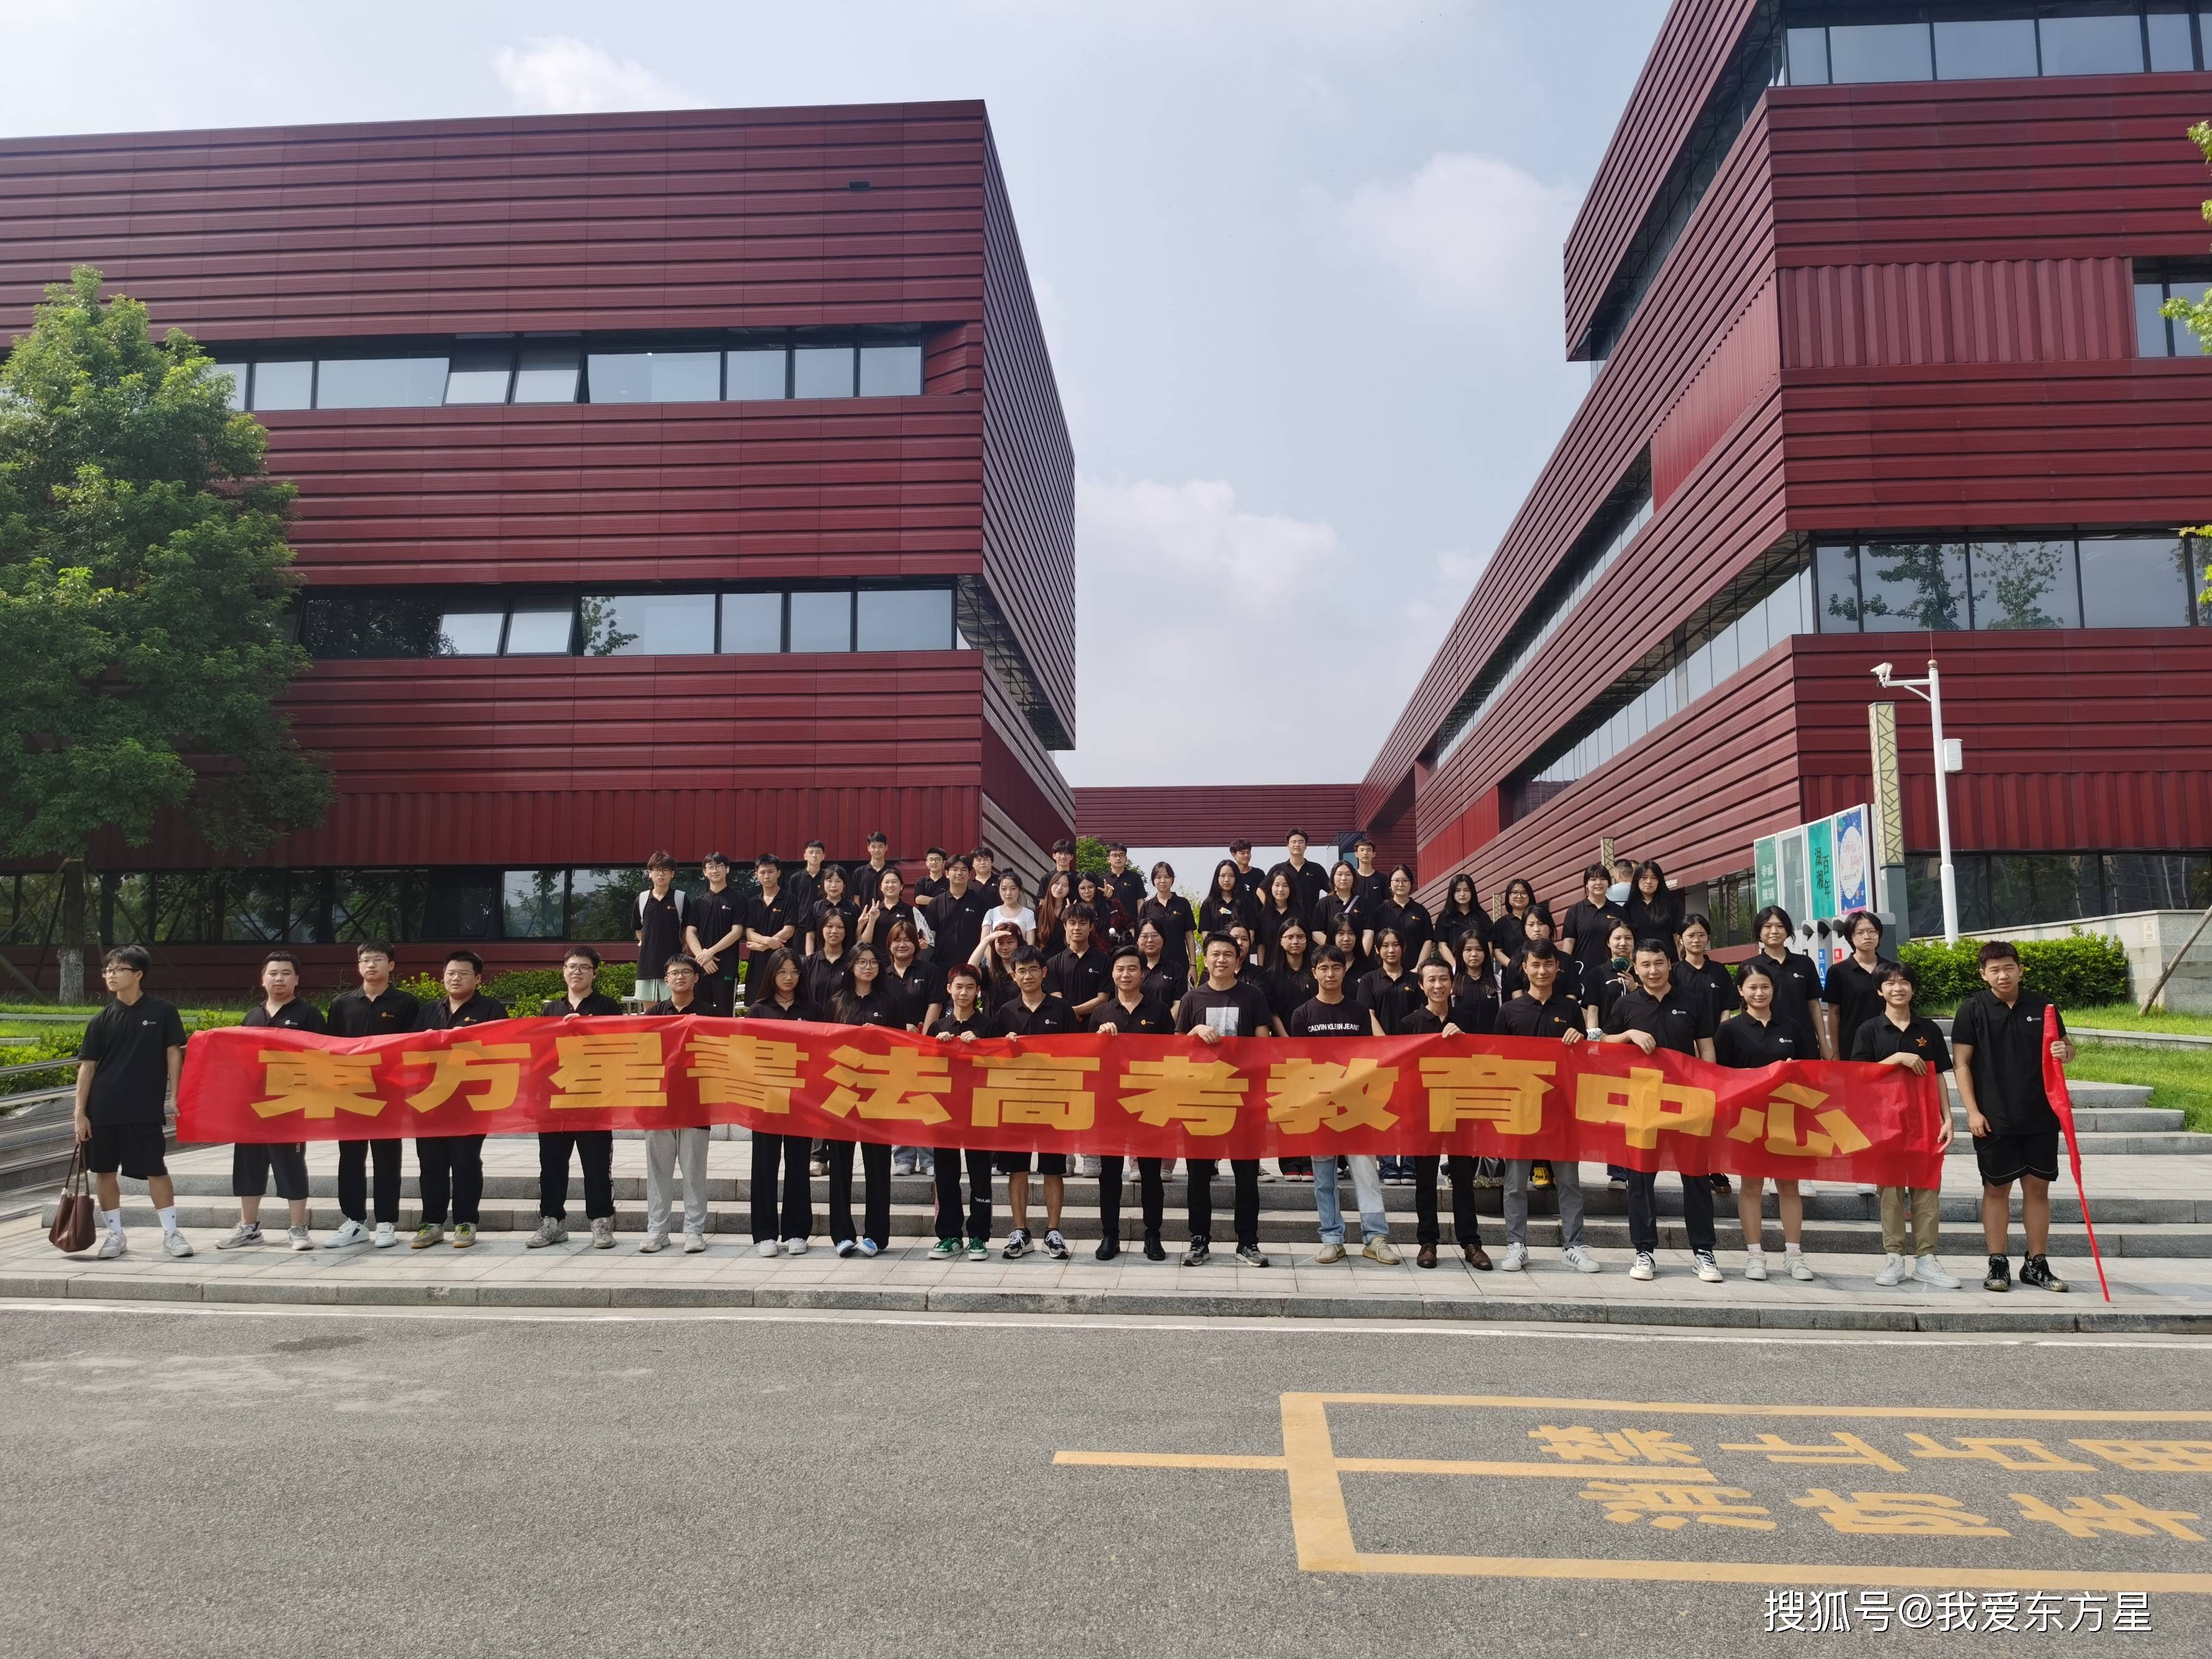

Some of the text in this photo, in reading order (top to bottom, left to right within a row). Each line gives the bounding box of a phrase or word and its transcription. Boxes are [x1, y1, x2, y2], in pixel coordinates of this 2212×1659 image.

[1822, 854, 1831, 899] 百年
[1307, 1024, 1327, 1032] CALVIN
[252, 1032, 1872, 1157] 東方星書法高考教育中心
